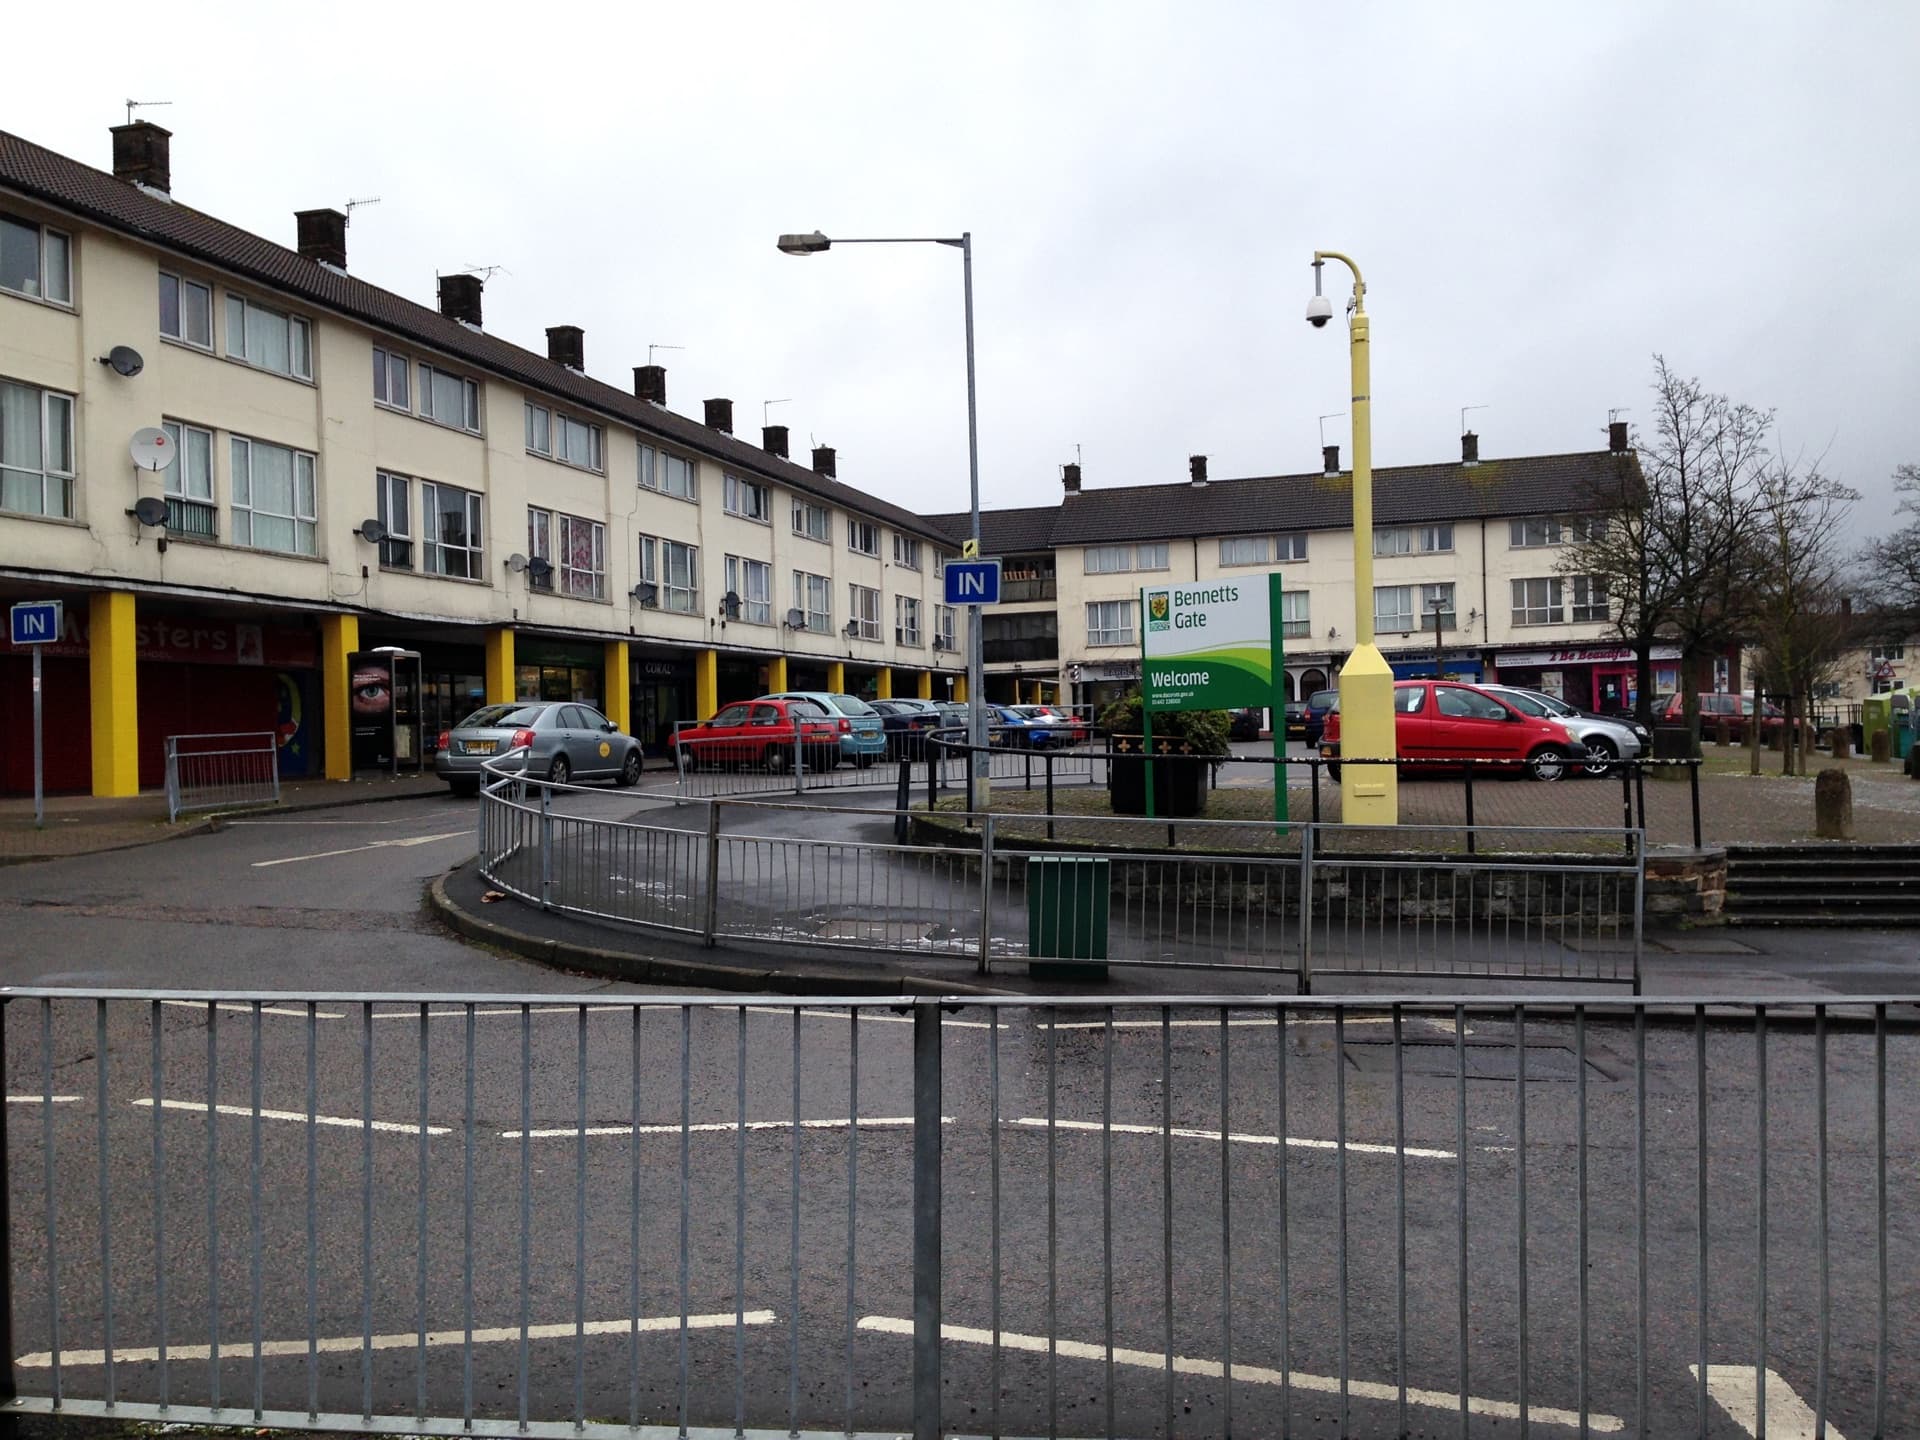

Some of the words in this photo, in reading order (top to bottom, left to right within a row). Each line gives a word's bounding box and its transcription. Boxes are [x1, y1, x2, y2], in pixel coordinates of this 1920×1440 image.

[958, 572, 985, 595] IN
[1174, 585, 1239, 607] Bennetts
[23, 613, 46, 635] IN
[1175, 611, 1207, 629] Gate
[1559, 650, 1576, 662] Be
[1578, 647, 1632, 661] Beautiful
[1151, 670, 1210, 688] Welcome
